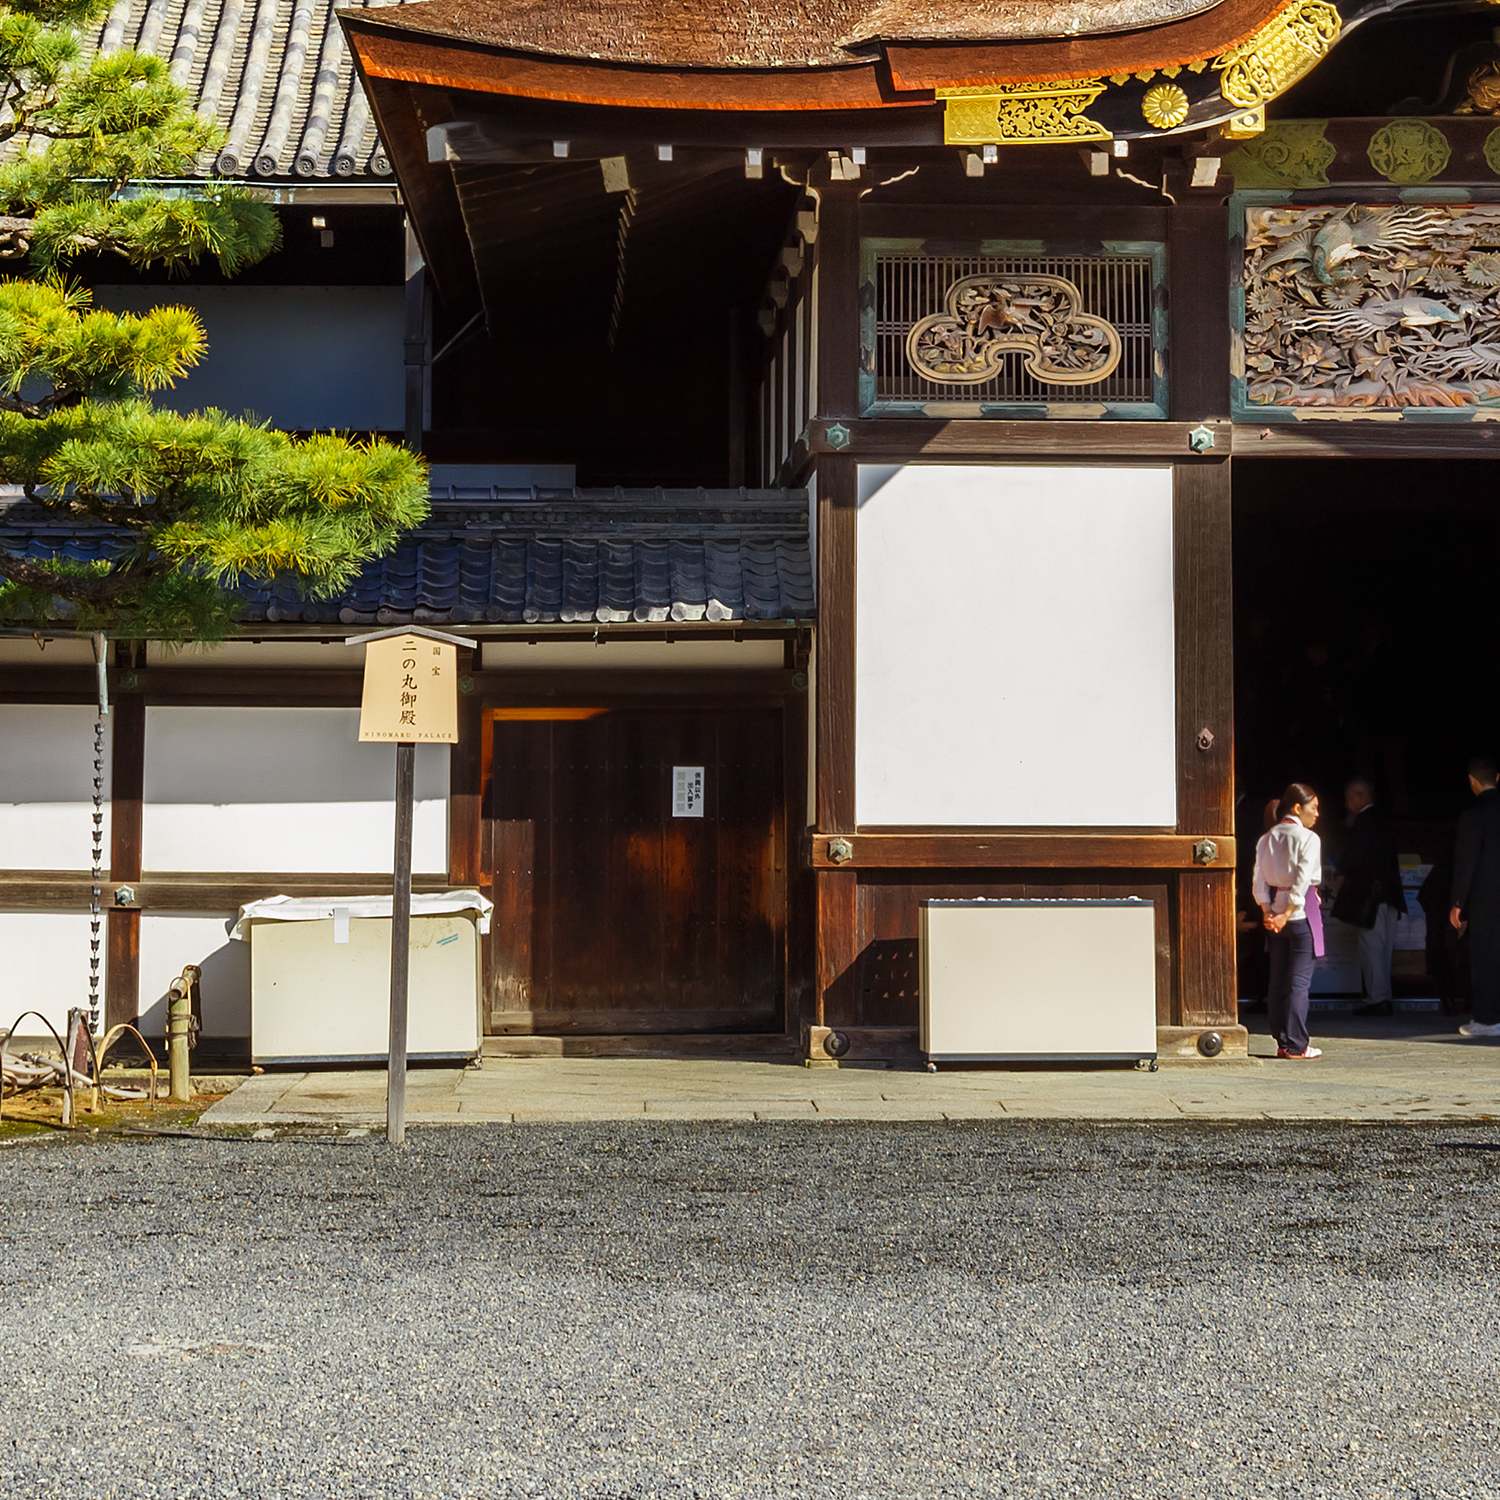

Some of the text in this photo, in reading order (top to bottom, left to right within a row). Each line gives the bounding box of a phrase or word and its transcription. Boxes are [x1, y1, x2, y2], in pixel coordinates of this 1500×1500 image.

[399, 641, 417, 725] 二の丸御殿
[432, 647, 441, 676] 国宝
